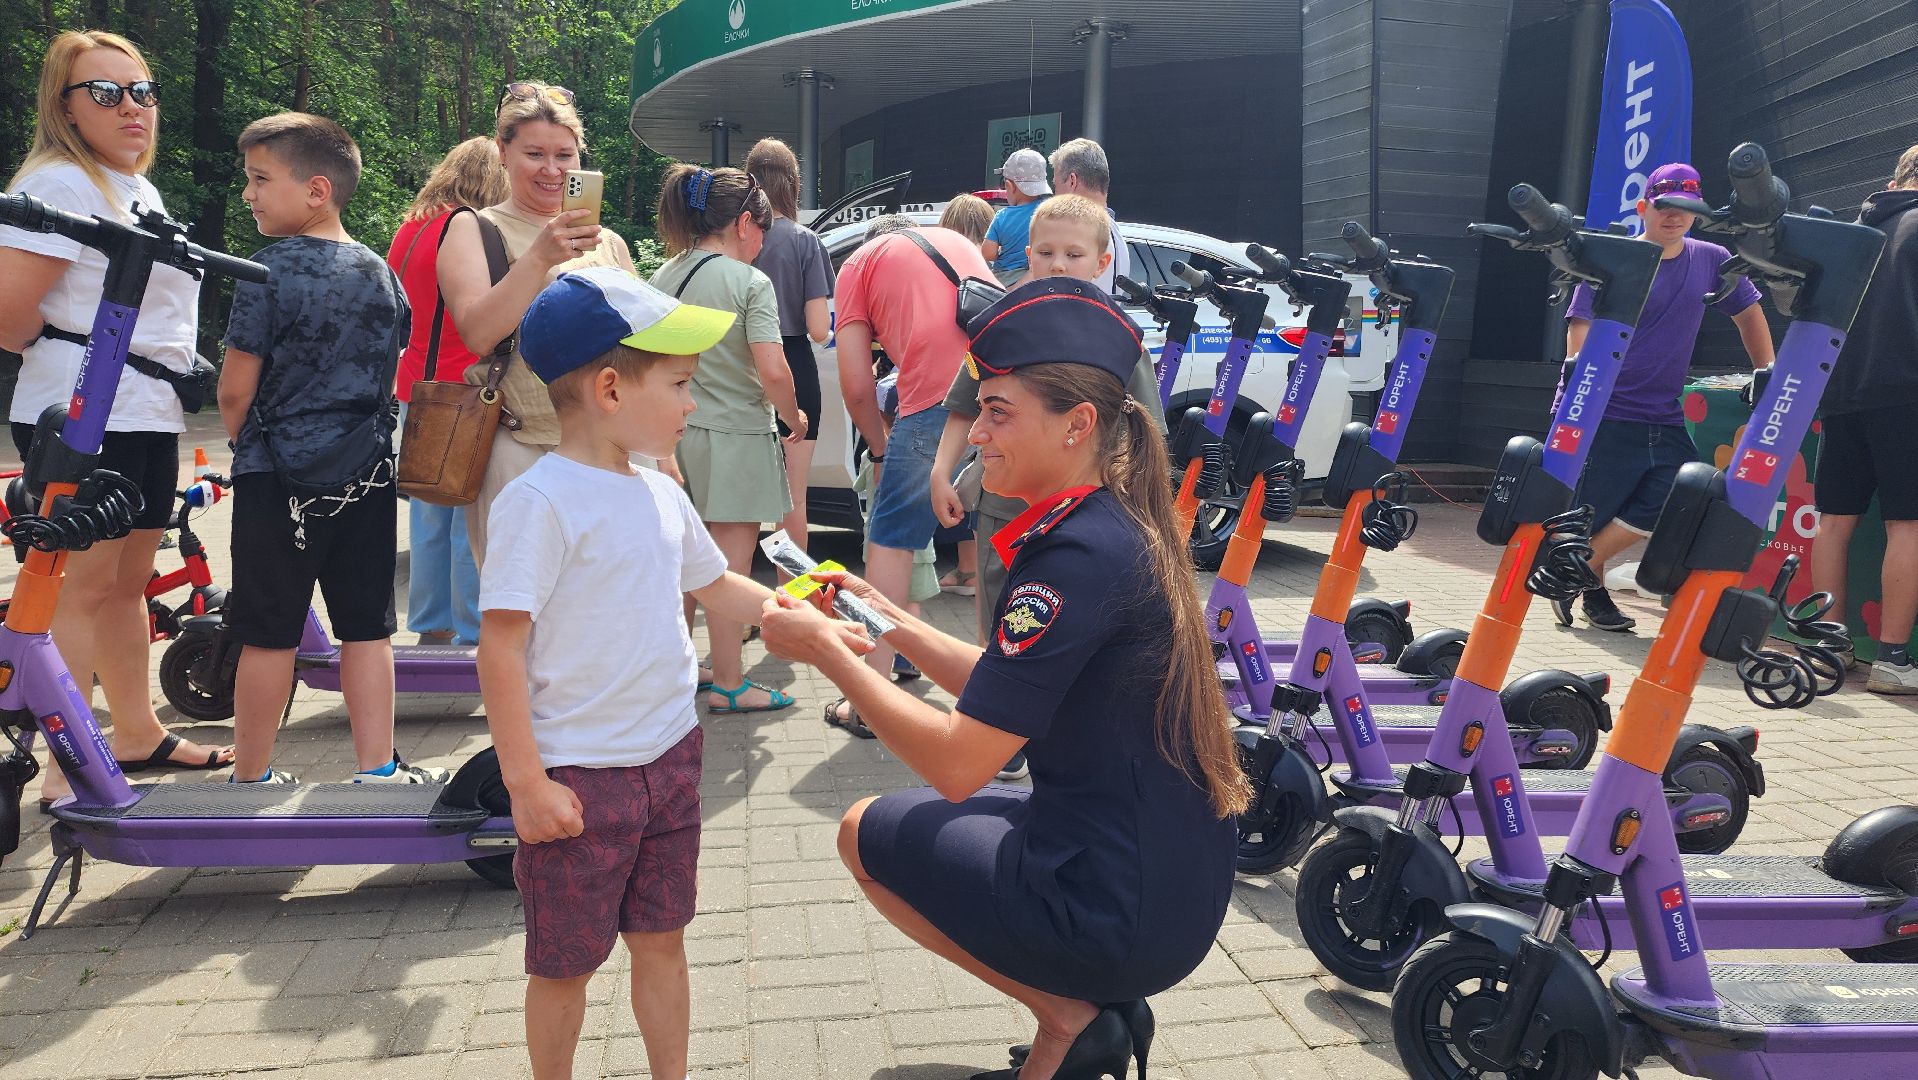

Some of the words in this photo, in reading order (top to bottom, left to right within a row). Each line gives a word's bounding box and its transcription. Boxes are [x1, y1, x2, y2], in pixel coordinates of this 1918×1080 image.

[1215, 362, 1233, 397] ЮРЕНТ
[1287, 361, 1308, 402] ЮРЕНТ
[1387, 361, 1410, 408] ЮРЕНТ
[1566, 362, 1598, 422] ЮРЕНТ
[1758, 373, 1802, 446] ЮРЕНТ
[1011, 597, 1049, 614] РОССИЯ
[1355, 713, 1371, 743] ЮРЕНТ
[57, 733, 81, 765] ЮРЕНТ
[1503, 797, 1519, 833] ЮРЕНТ
[1671, 911, 1691, 953] ЮРЕНТ
